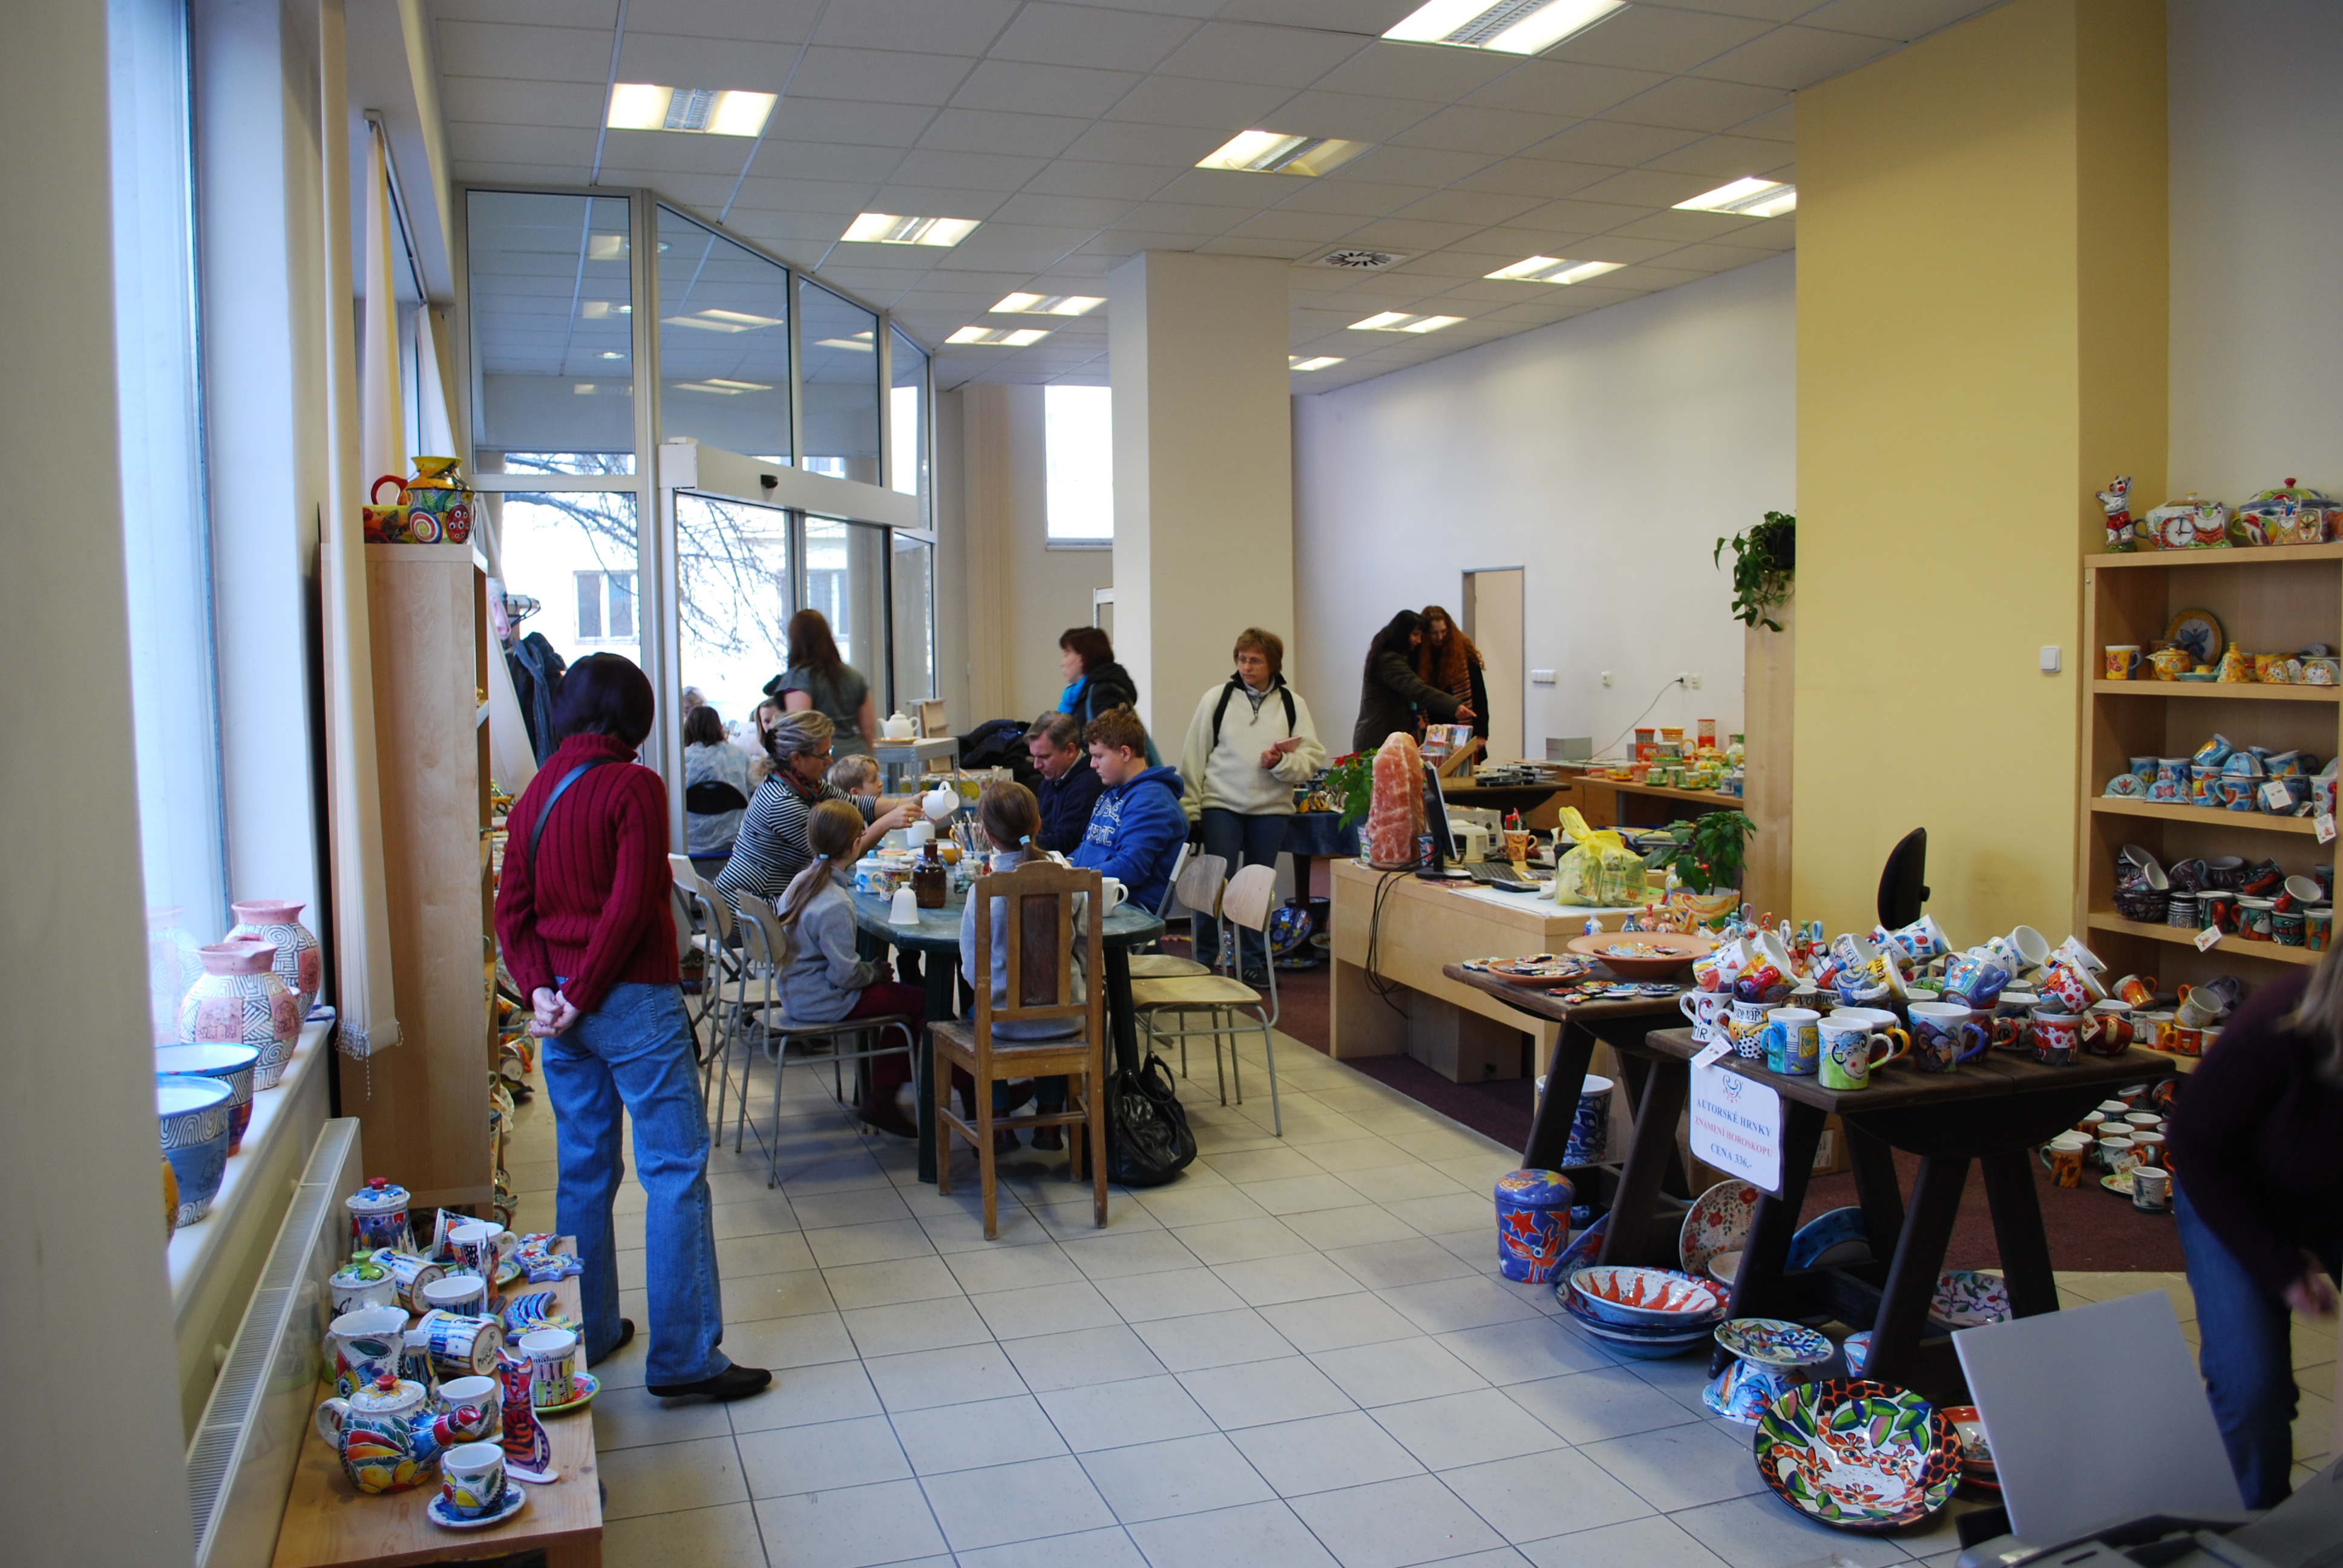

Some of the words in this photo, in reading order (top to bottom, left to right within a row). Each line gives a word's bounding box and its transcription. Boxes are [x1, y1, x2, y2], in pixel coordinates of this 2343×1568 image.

[1695, 1116, 1725, 1137] ZNAMENÍ
[1726, 1130, 1773, 1158] HOROSKOPU
[1696, 1098, 1738, 1124] AUTORSKÉ
[1740, 1116, 1772, 1137] HRNKY
[1711, 1143, 1732, 1161] CENA
